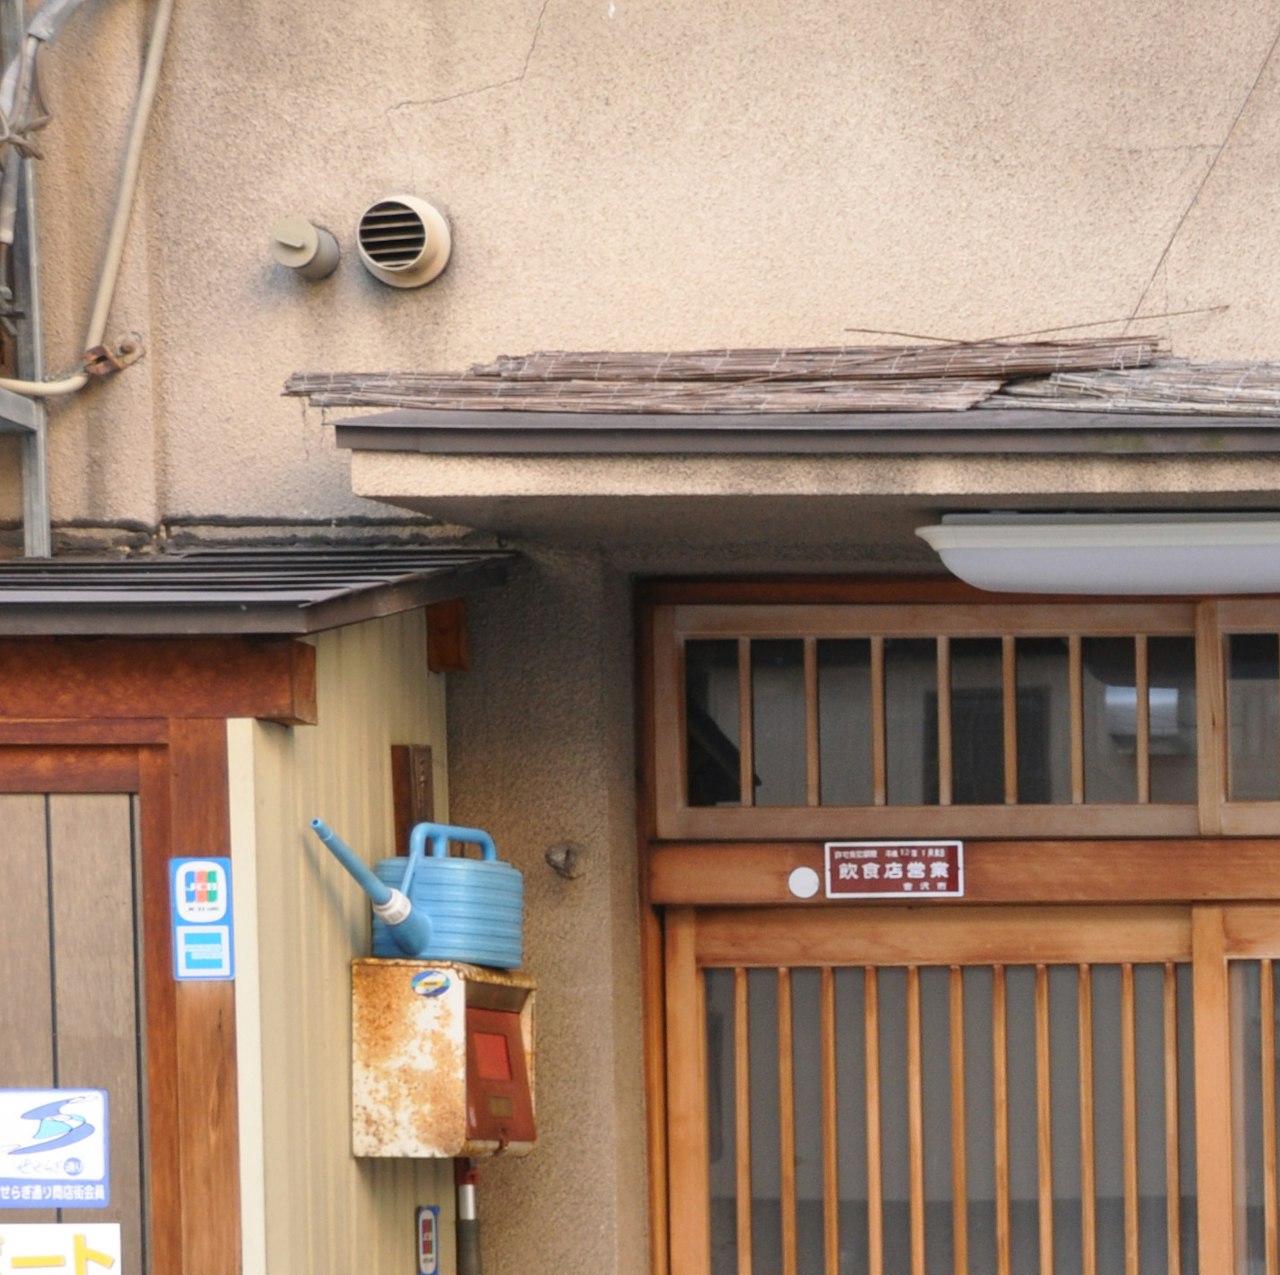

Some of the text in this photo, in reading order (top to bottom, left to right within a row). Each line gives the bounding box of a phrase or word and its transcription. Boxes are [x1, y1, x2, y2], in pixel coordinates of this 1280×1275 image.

[838, 862, 950, 879] 飲食店営業
